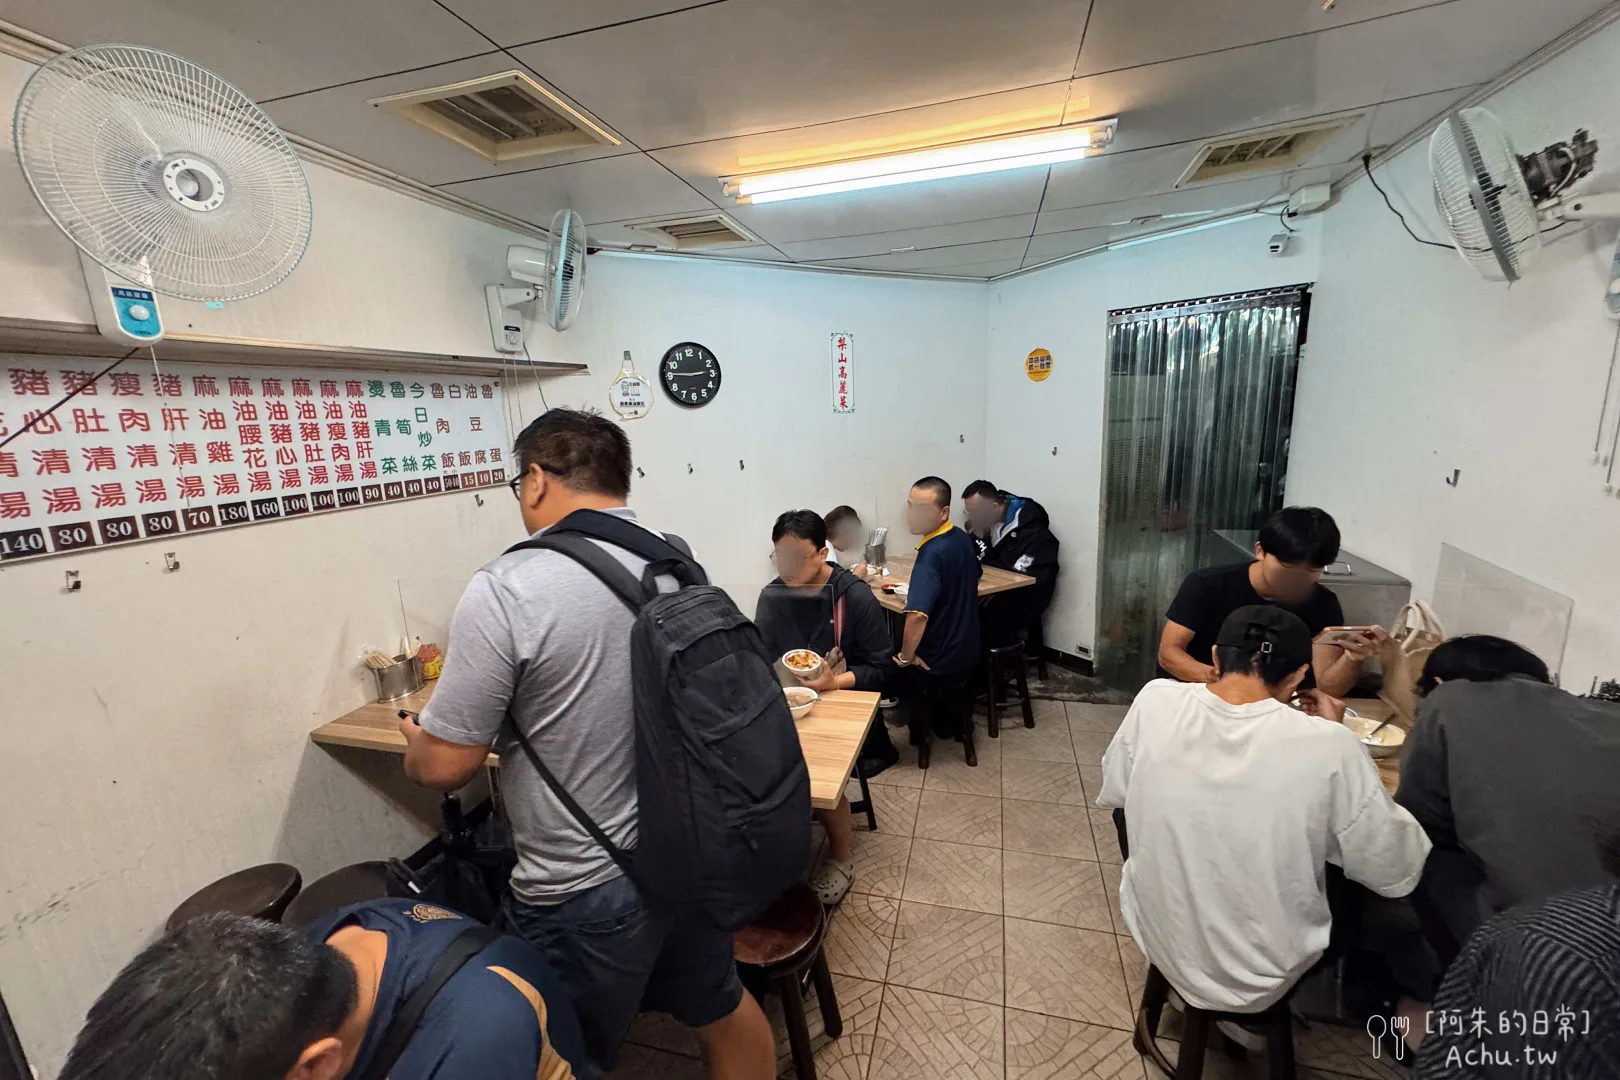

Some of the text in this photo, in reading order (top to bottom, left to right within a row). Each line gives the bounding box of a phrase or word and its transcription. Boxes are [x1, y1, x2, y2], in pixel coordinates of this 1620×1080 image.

[676, 352, 682, 360] 11
[684, 348, 694, 357] 12
[698, 351, 702, 360] 1
[669, 361, 678, 370] 10
[706, 360, 712, 368] 2
[667, 372, 674, 380] 9
[710, 370, 716, 378] 3
[837, 336, 848, 409] 梨山高麗菜
[672, 382, 678, 392] 8
[708, 380, 714, 389] 4
[680, 390, 687, 398] 7
[691, 392, 698, 400] 6
[701, 388, 707, 397] 5
[151, 373, 205, 499] 豬肝清湯
[192, 374, 240, 496] 麻油雞湯
[228, 376, 272, 492] 麻油腰花湯
[261, 377, 302, 489] 麻油豬心湯
[291, 378, 329, 485] 麻油豬肚湯
[319, 379, 354, 482] 麻油瘦肉湯
[345, 379, 377, 479] 麻油豬肝湯
[8, 368, 82, 514] 豬心清湯
[60, 369, 126, 508] 豬肚清湯
[108, 372, 167, 503] 瘦肉清湯
[464, 476, 474, 486] 15
[480, 474, 489, 484] 10
[494, 470, 503, 480] 20
[388, 485, 400, 496] 40
[408, 482, 420, 493] 40
[426, 480, 440, 490] 40
[312, 493, 334, 507] 100
[338, 490, 359, 504] 100
[365, 488, 379, 499] 90
[254, 502, 278, 517] 160
[283, 497, 308, 512] 100
[188, 511, 210, 526] 70
[219, 505, 248, 521] 180
[105, 521, 132, 538] 80
[148, 515, 172, 531] 80
[58, 527, 87, 545] 80
[0, 533, 43, 555] 140
